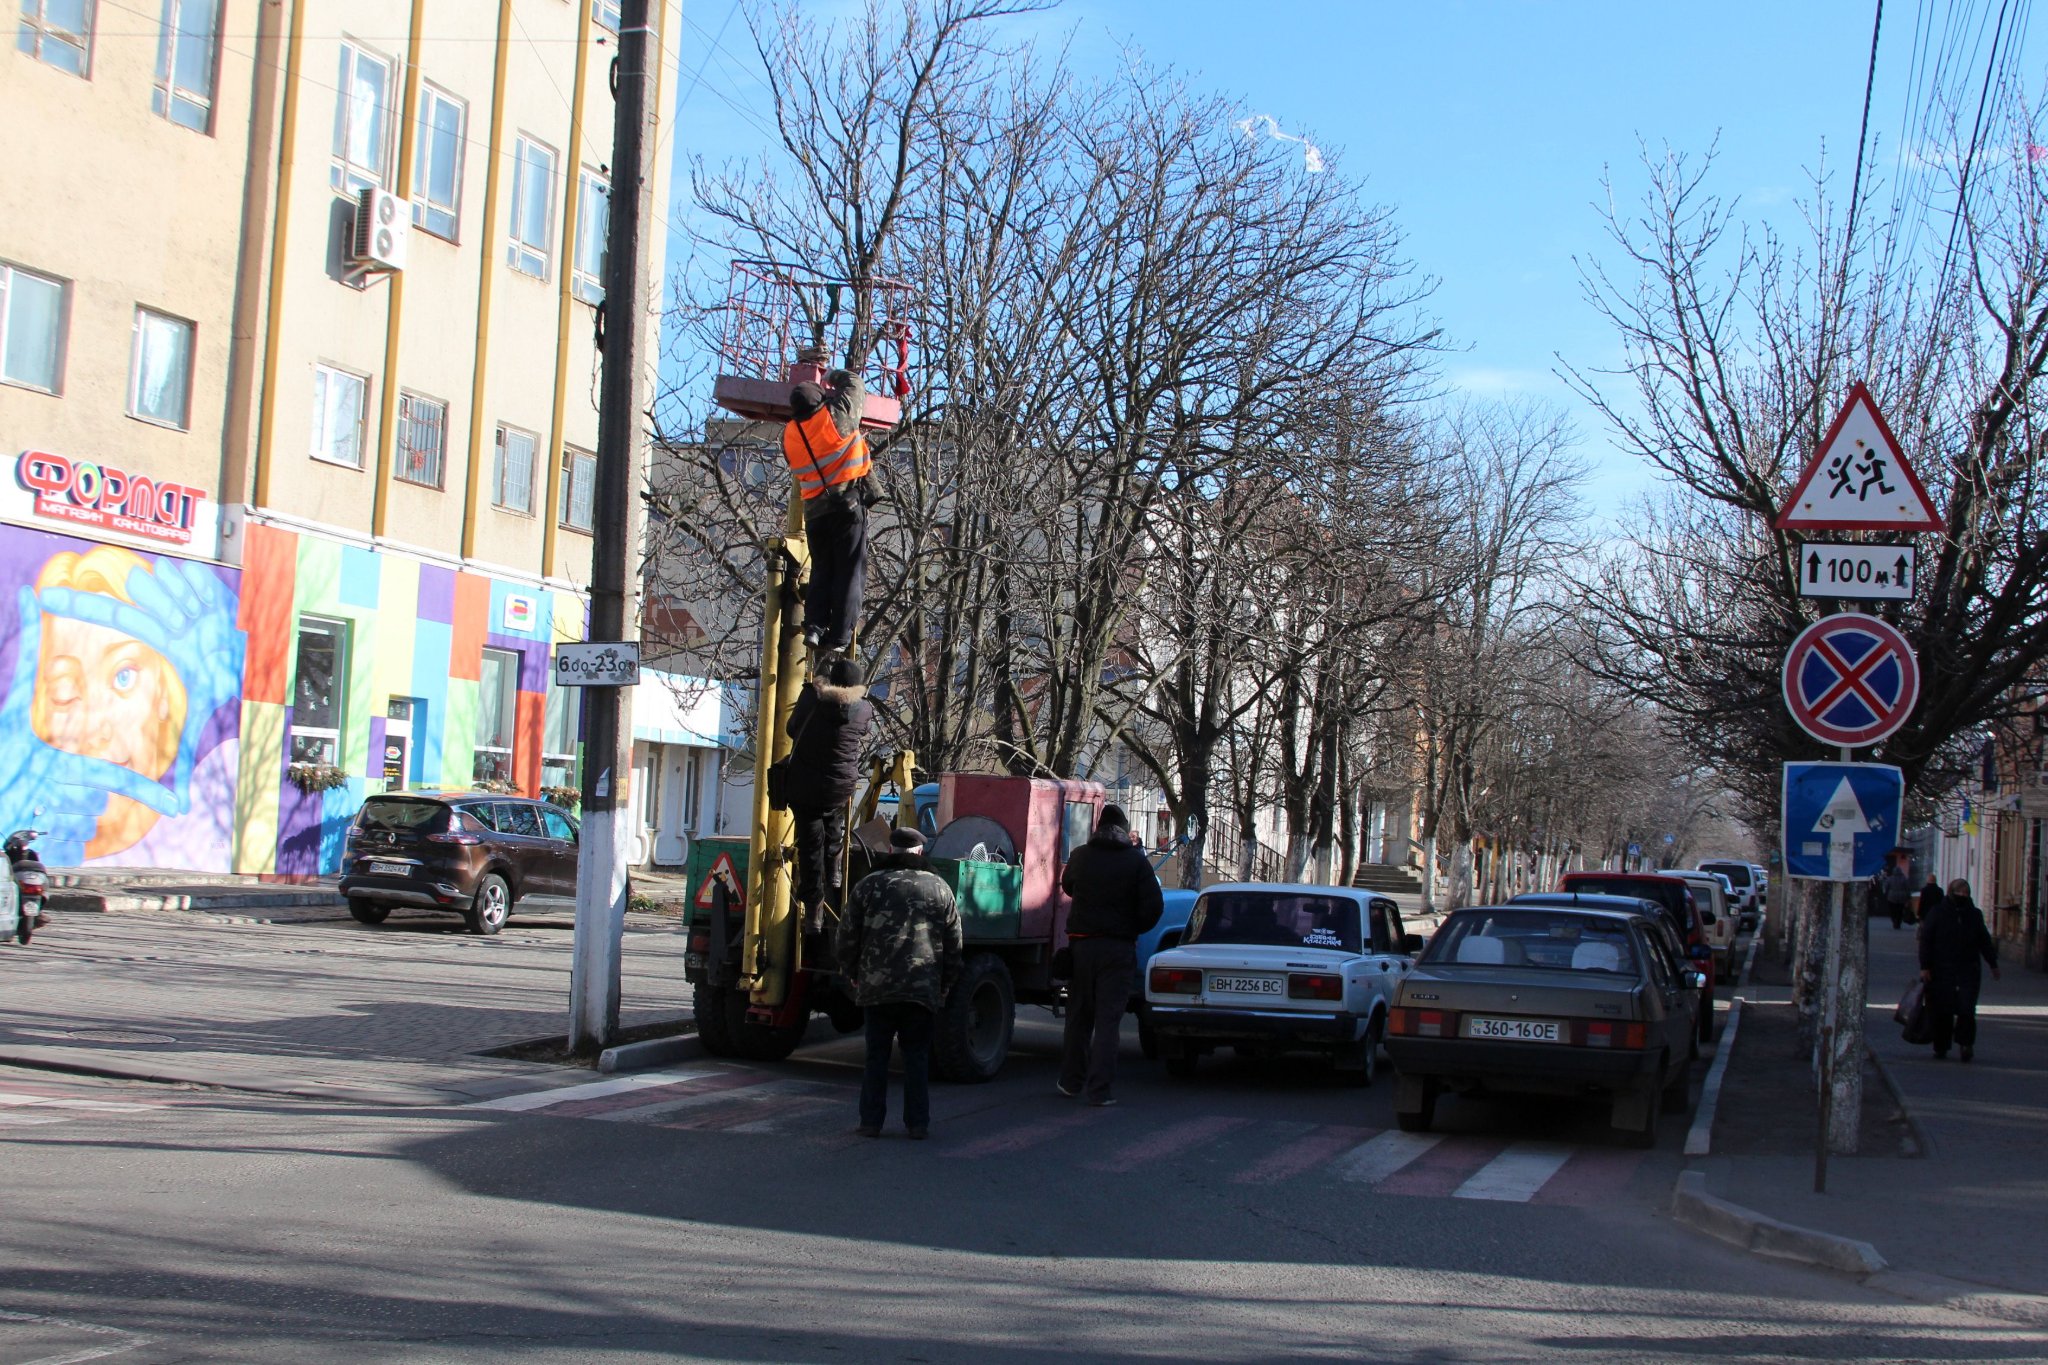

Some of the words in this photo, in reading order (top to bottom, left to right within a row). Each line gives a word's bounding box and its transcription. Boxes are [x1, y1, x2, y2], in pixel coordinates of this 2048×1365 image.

[14, 450, 207, 531] ФОРМАТ
[40, 502, 104, 523] МАГАЗИН
[1827, 559, 1871, 583] 100
[1216, 979, 1232, 990] BH
[1235, 980, 1260, 991] 2256
[1262, 980, 1279, 992] BC
